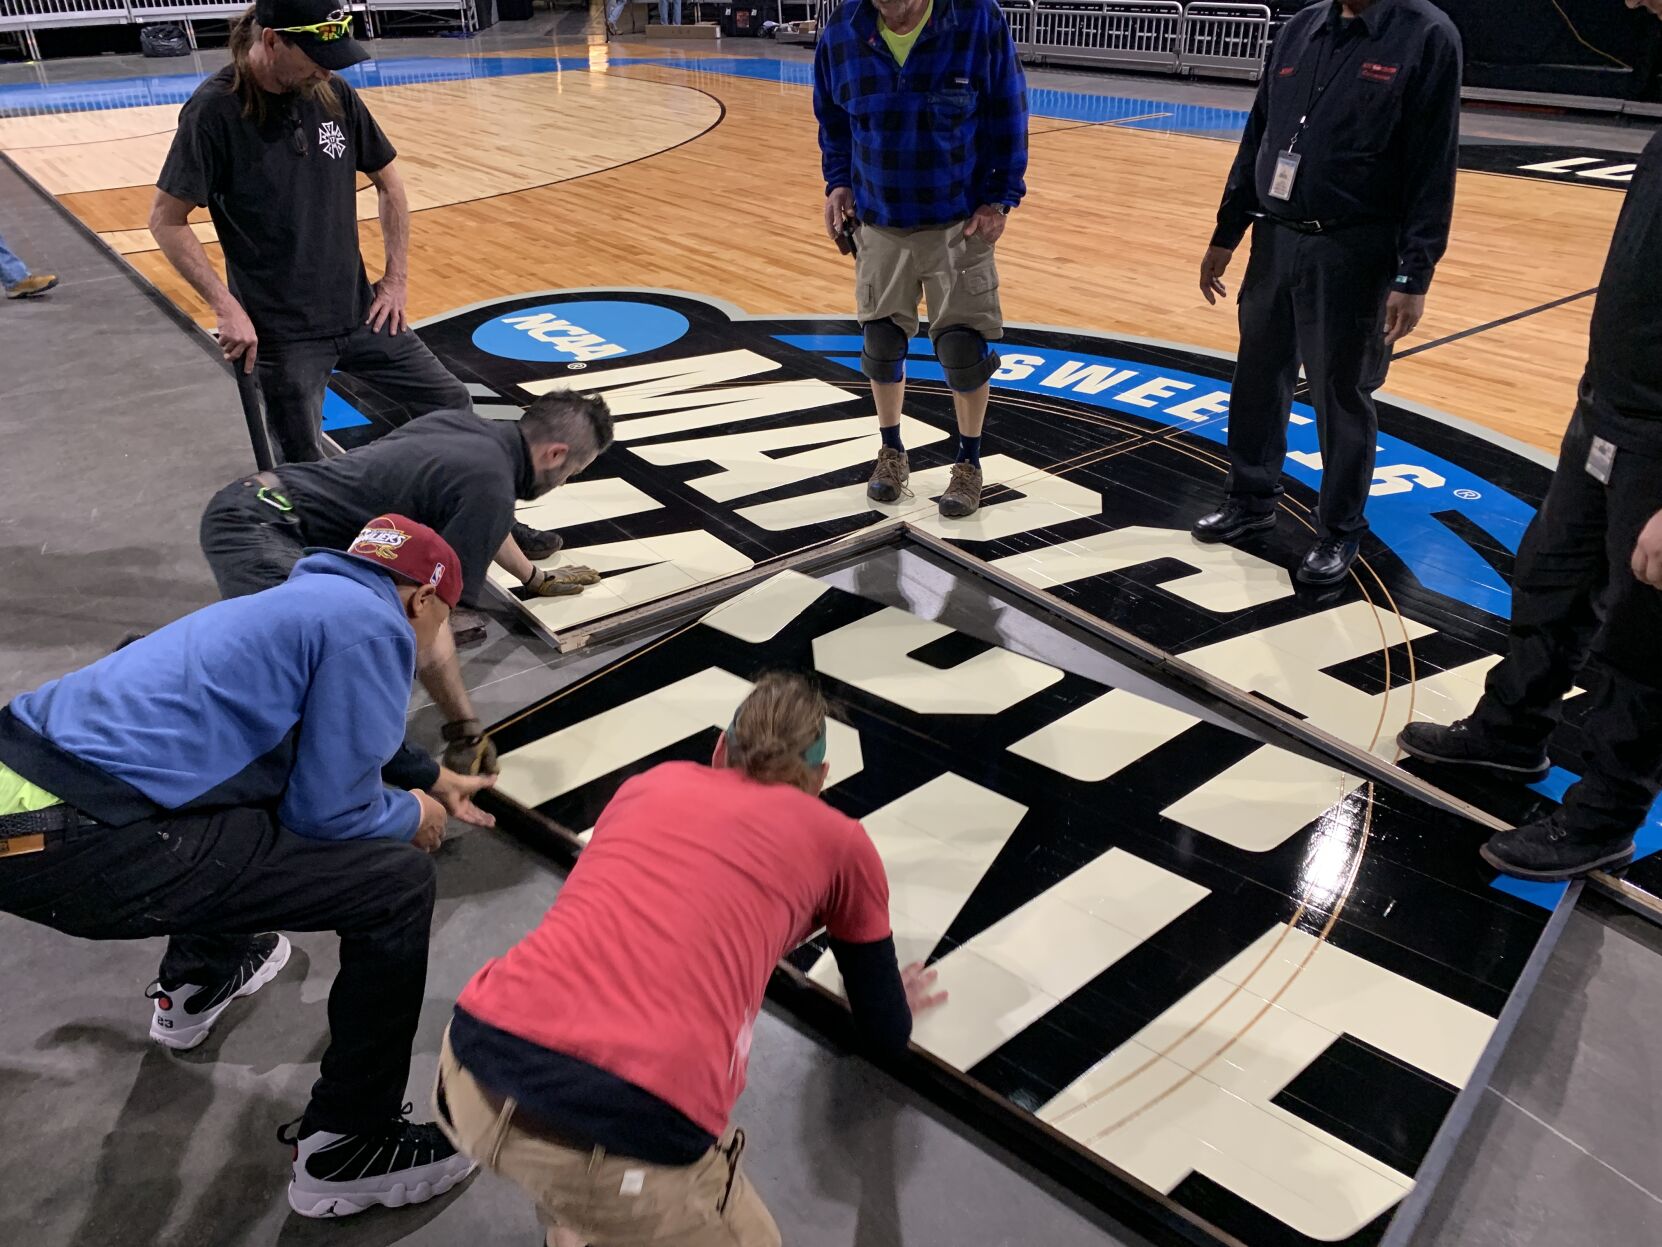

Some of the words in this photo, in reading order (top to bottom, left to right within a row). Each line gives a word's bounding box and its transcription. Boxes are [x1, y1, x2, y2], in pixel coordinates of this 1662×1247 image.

[501, 313, 627, 361] NCAA
[994, 353, 1315, 433] SWEE
[157, 1015, 174, 1029] 23
